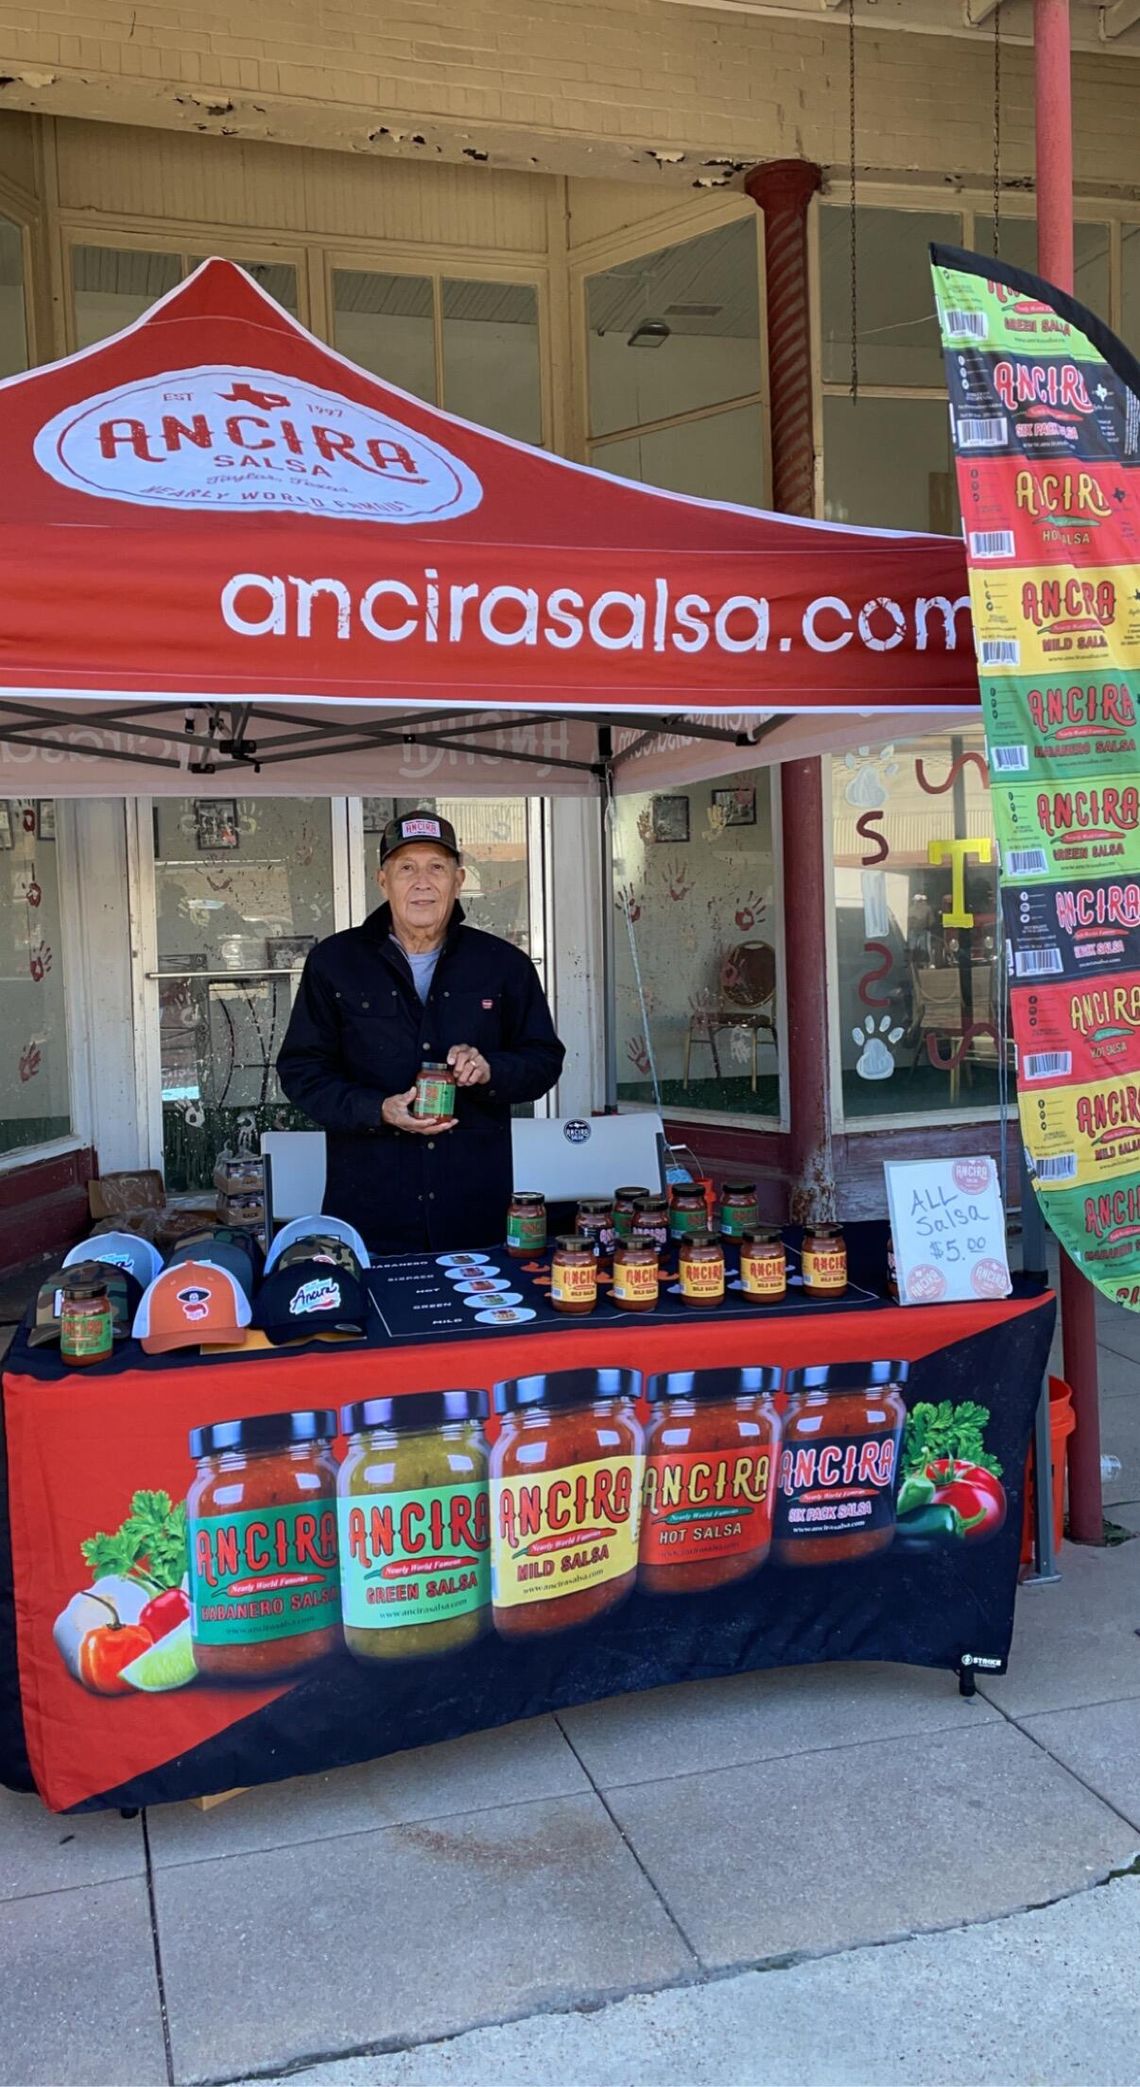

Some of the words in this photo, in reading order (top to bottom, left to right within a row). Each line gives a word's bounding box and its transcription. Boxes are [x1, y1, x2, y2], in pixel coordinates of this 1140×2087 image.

[163, 392, 193, 403] EST
[96, 414, 430, 485] ANCIRA
[214, 453, 333, 478] SALSA
[139, 485, 230, 500] NEARLY
[241, 491, 324, 508] WORLD
[220, 568, 974, 655] ancirasalsa.com
[1027, 683, 1137, 734] ANCIRA
[1037, 786, 1140, 837] ANCIRA
[955, 1164, 990, 1181] ANCIRA
[911, 1186, 959, 1217] ALL
[916, 1204, 990, 1237] Salsa
[641, 1456, 769, 1515] ANCIRA
[779, 1439, 894, 1497] ANCIRA
[499, 1466, 633, 1549] ANCIRA
[788, 1507, 805, 1522] SIX
[806, 1505, 835, 1521] PACK
[837, 1501, 872, 1519] SALSA
[196, 1511, 338, 1587] ANCIRA
[349, 1492, 491, 1569] ANCIRA
[660, 1529, 686, 1544] HOT
[693, 1522, 742, 1541] SALSA
[517, 1560, 556, 1583] MILD
[561, 1544, 610, 1573] SALSA
[256, 1578, 279, 1591] World
[366, 1582, 420, 1605] GREEN
[426, 1570, 478, 1598] SALSA
[201, 1598, 285, 1623] HABANERO
[291, 1586, 338, 1611] SALSA
